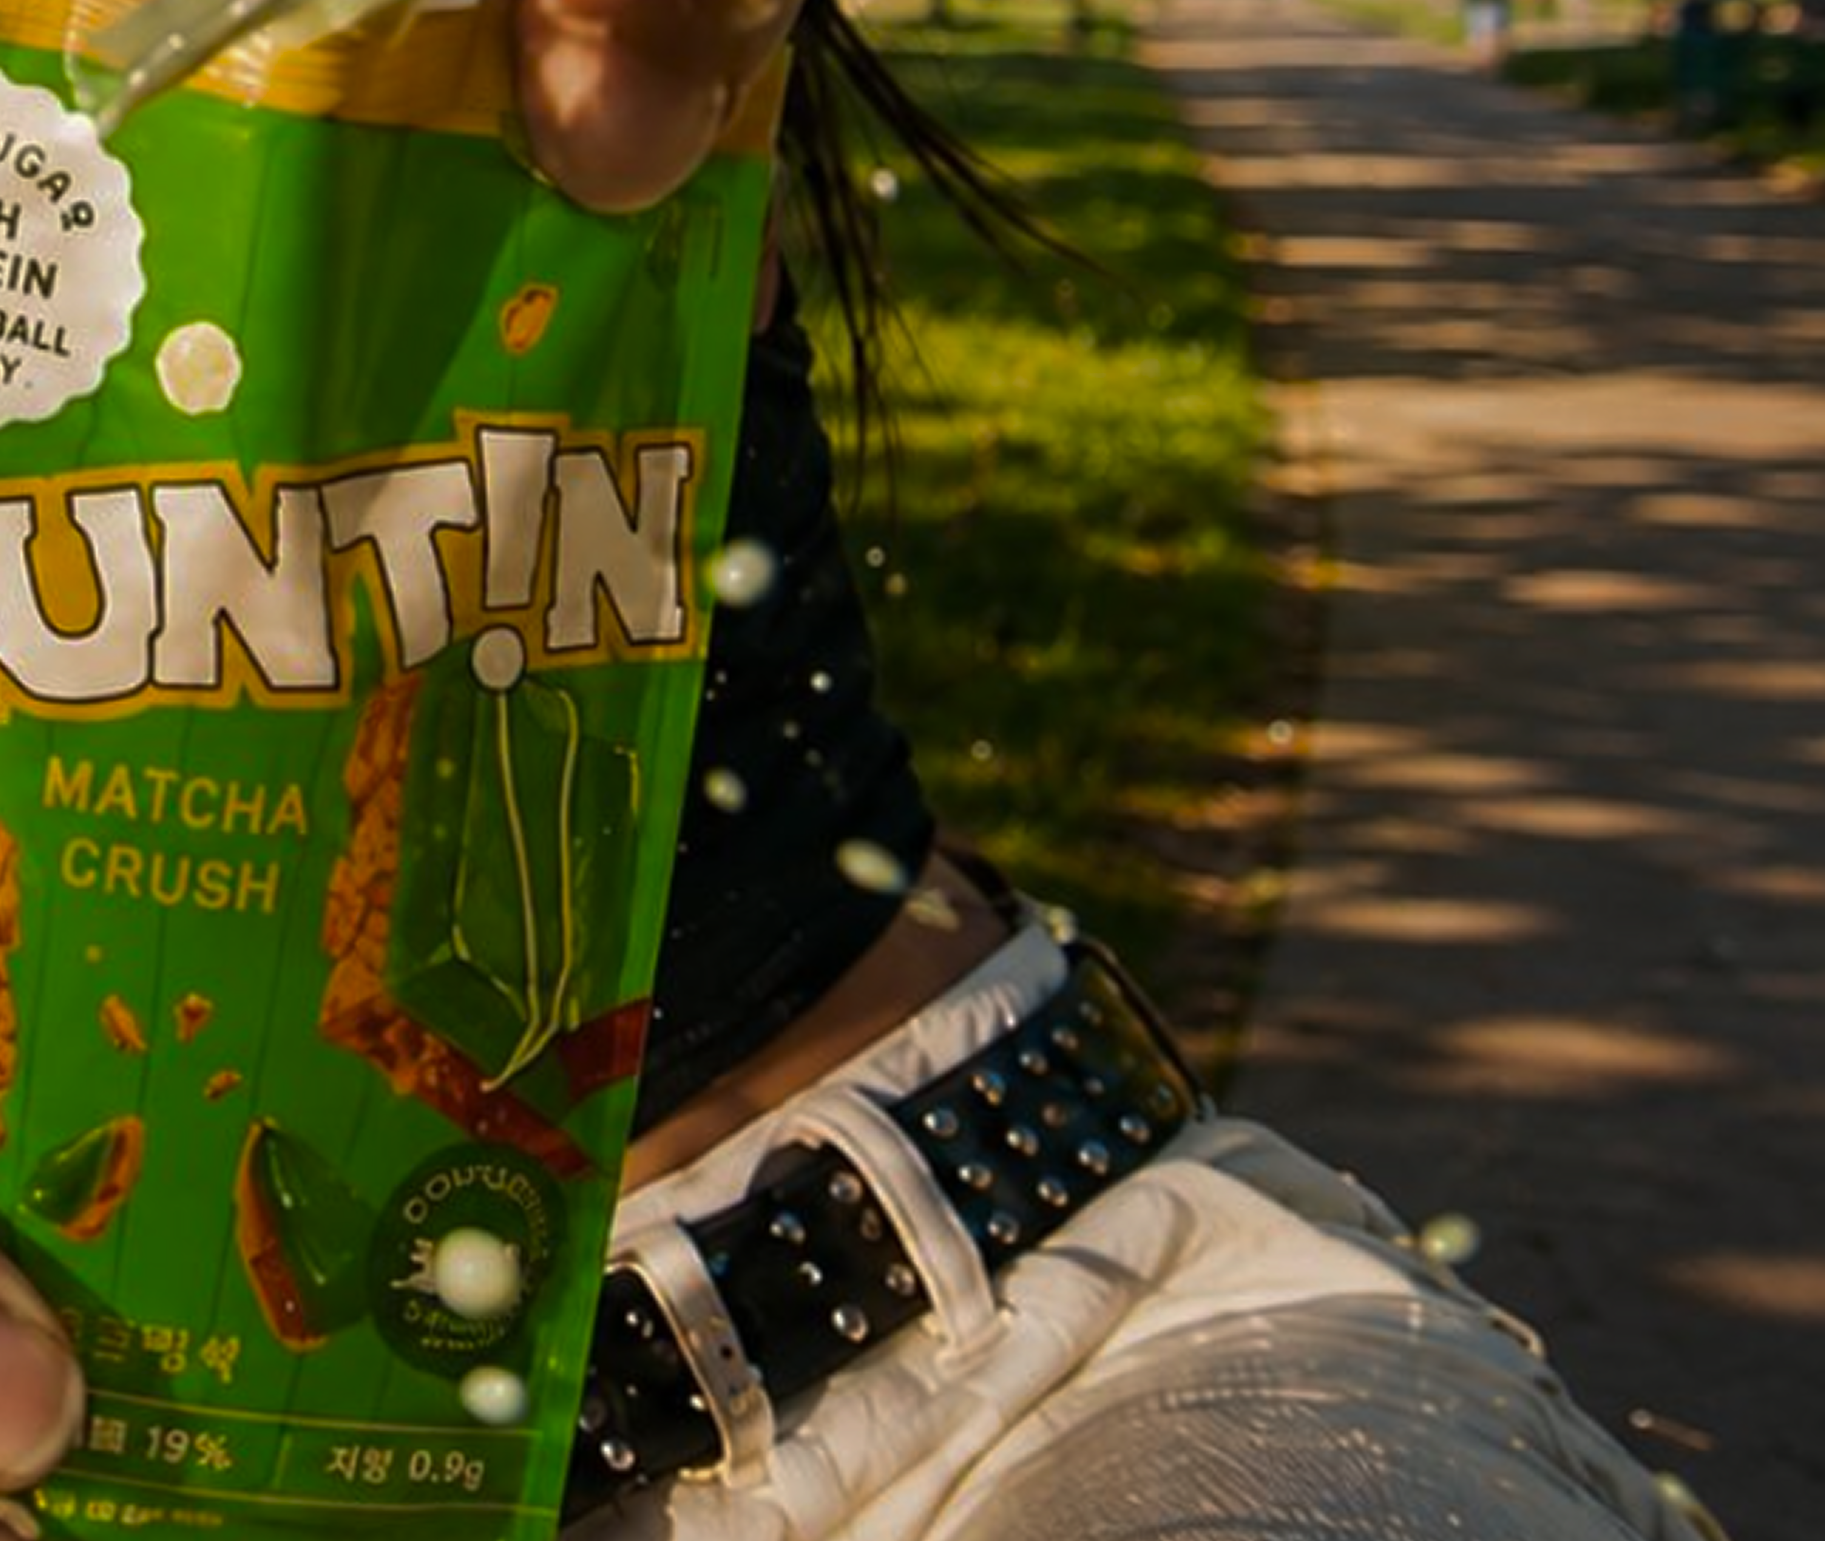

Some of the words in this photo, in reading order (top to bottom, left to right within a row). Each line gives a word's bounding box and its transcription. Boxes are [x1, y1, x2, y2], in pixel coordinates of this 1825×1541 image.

[41, 756, 309, 836] MATCHA
[60, 840, 281, 913] CRUSH
[147, 1424, 234, 1470] 19%
[408, 1449, 485, 1492] 0.9g
